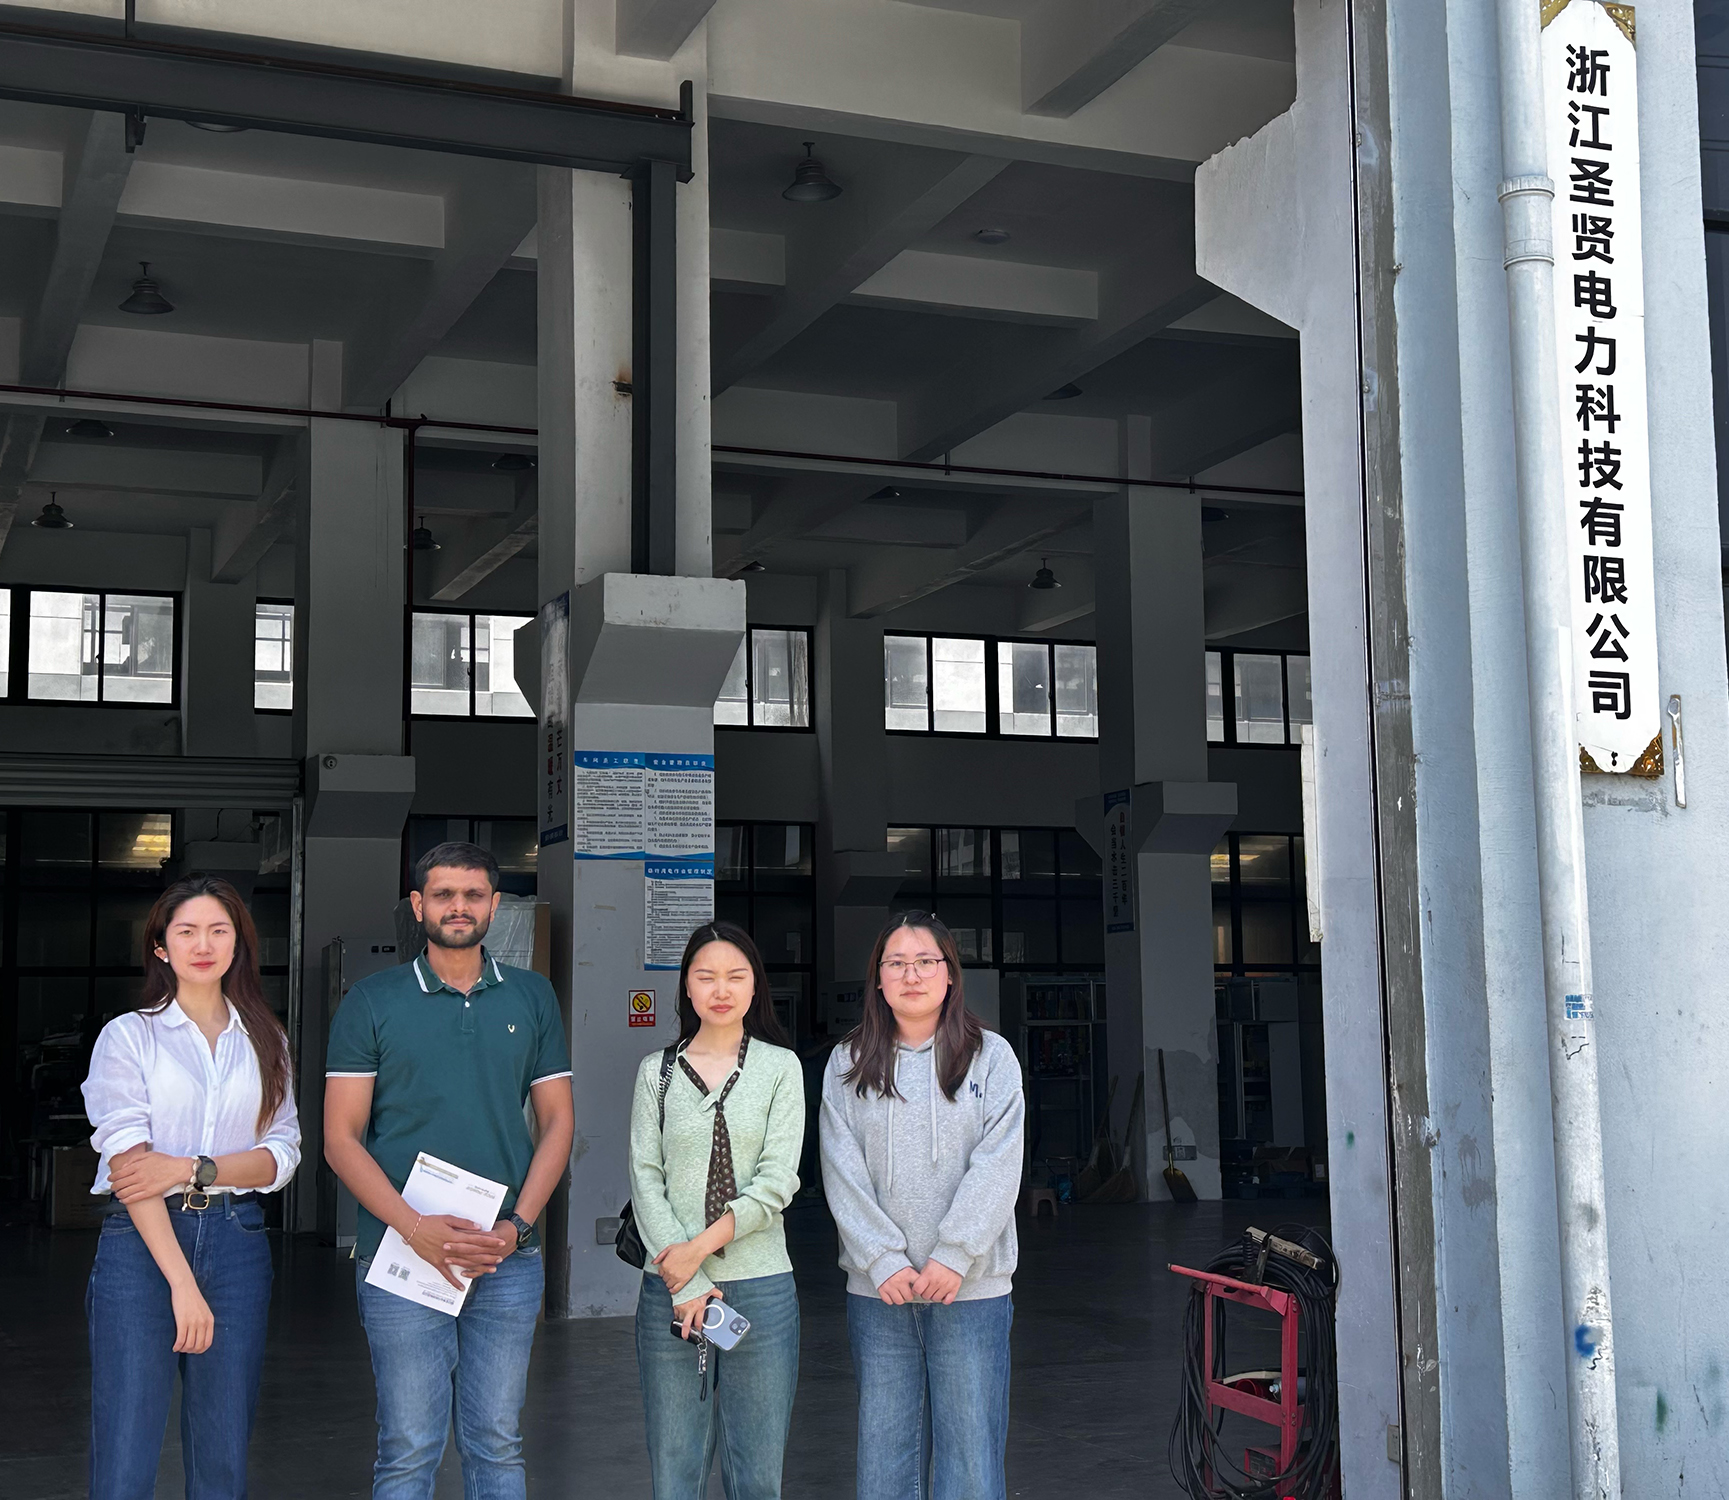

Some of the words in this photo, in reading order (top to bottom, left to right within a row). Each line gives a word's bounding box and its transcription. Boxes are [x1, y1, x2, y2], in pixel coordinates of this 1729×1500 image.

[1566, 44, 1632, 720] 浙江圣贤电力科技有限公司
